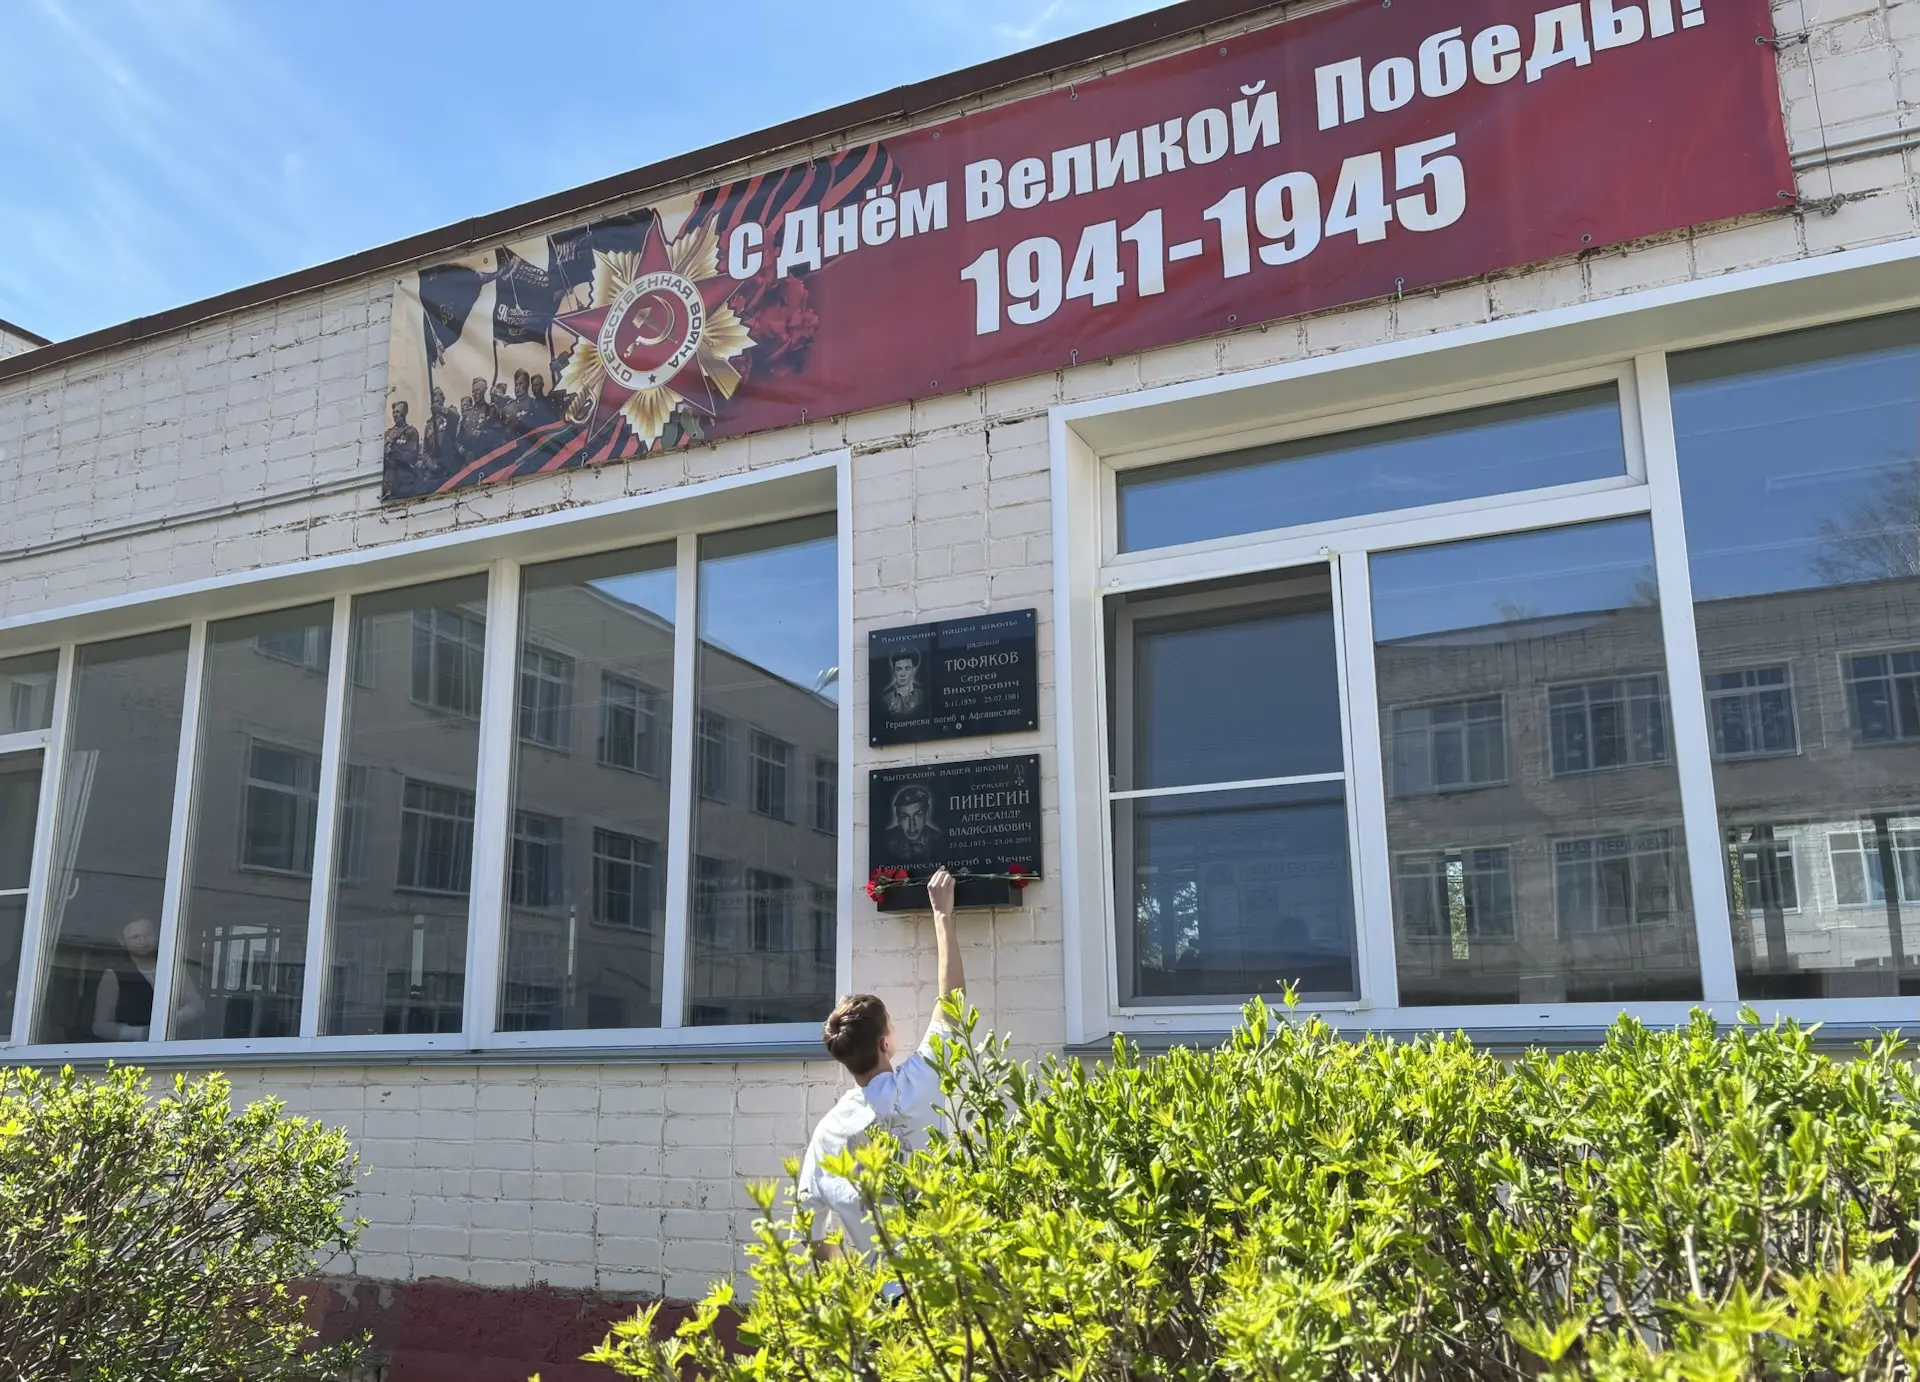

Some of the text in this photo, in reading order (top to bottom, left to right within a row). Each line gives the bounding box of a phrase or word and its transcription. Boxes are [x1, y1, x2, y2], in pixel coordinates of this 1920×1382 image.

[777, 181, 948, 279] Днём
[964, 79, 1280, 222] Великой
[960, 132, 1467, 335] 1941-1945
[604, 276, 694, 382] ОТЕЧЕСТВЕННАЯ
[945, 651, 1019, 672] ТЮФЯКОВ
[960, 672, 997, 683] Сергей
[943, 680, 1020, 695] Викторович
[933, 714, 957, 725] погиб
[883, 771, 936, 782] ВЫПУСКНИК
[975, 763, 1009, 774] ШКОЛЫ
[949, 789, 1030, 811] ПИНЕГИН
[961, 809, 1021, 823] АЛЕКСАНДР
[949, 822, 1032, 837] ВЛАДИСЛАВОВИЧ
